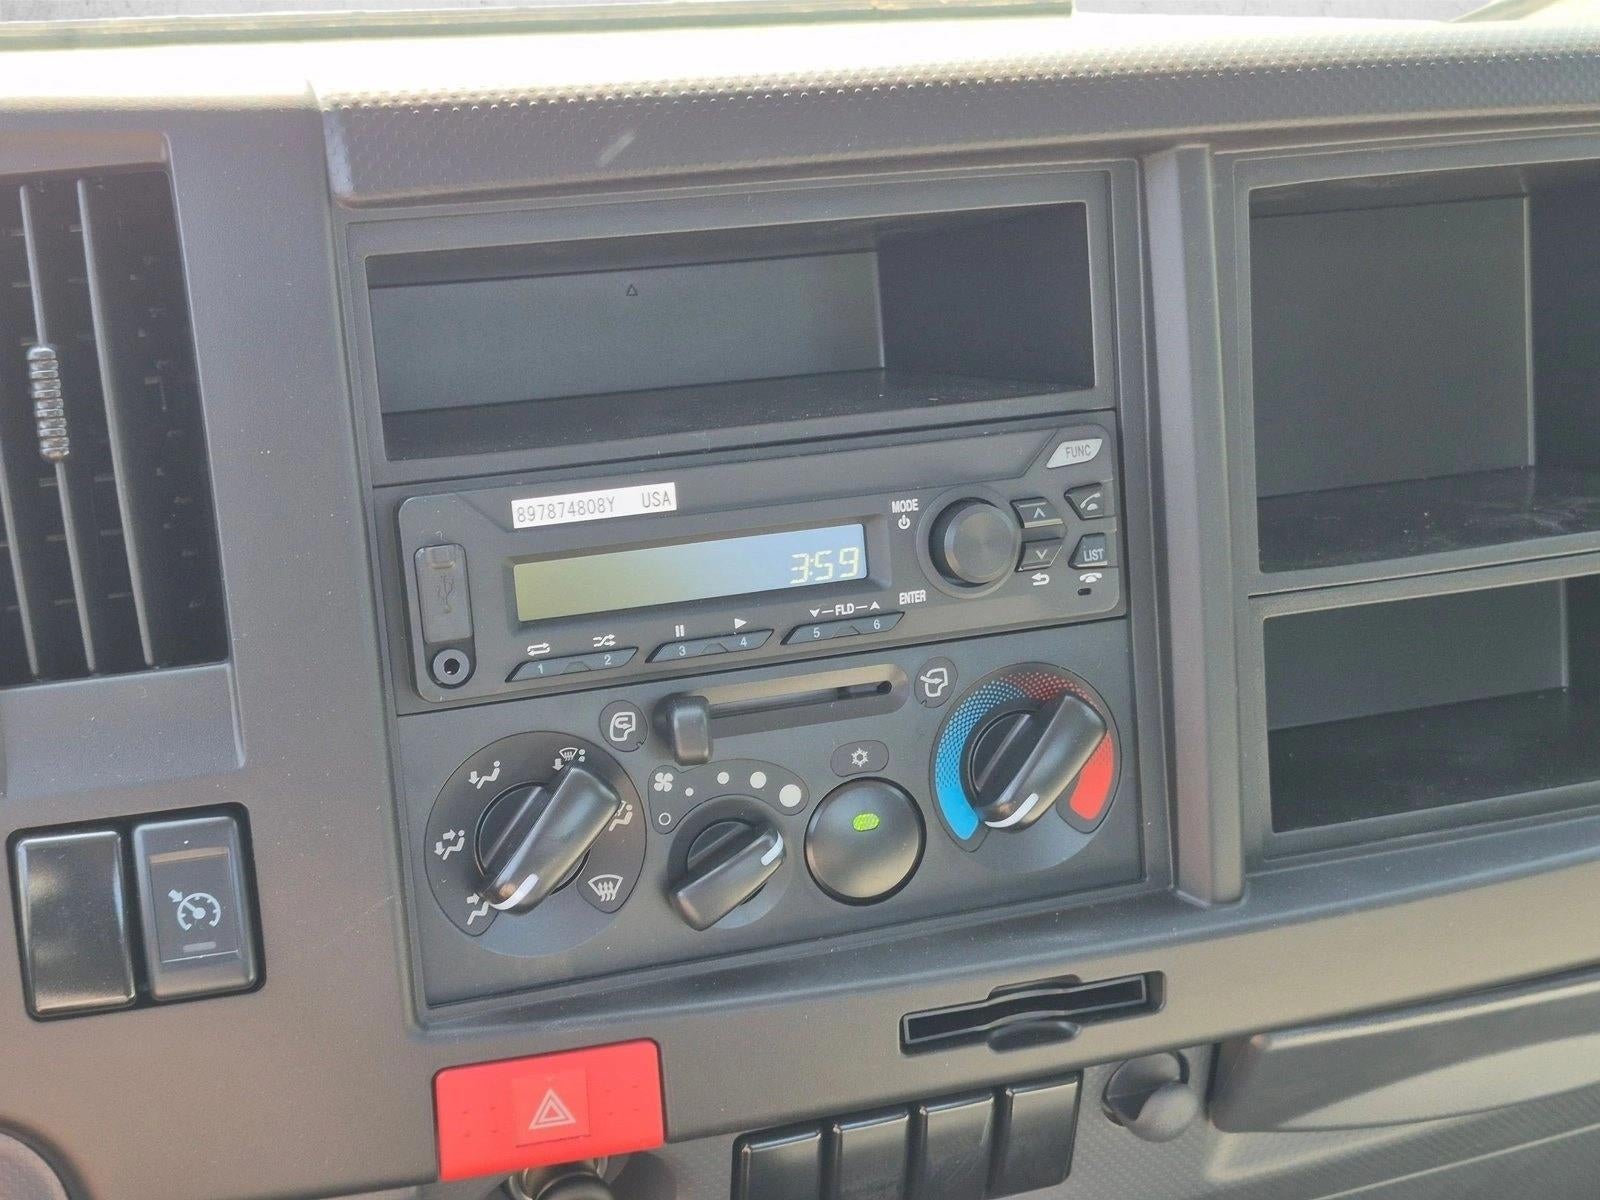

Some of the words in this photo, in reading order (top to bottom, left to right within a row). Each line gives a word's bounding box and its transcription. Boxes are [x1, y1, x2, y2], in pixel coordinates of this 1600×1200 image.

[1064, 443, 1092, 458] FUNC
[516, 496, 616, 523] 897874808Y
[641, 489, 672, 508] USA
[891, 498, 919, 513] MODE
[1083, 547, 1105, 562] LIST
[790, 546, 860, 585] 3:59
[898, 589, 927, 605] ENTER
[834, 602, 855, 616] FLD
[873, 618, 881, 630] 6
[812, 627, 820, 638] 5
[739, 637, 747, 647] 4
[678, 645, 686, 656] 3
[604, 654, 612, 665] 2
